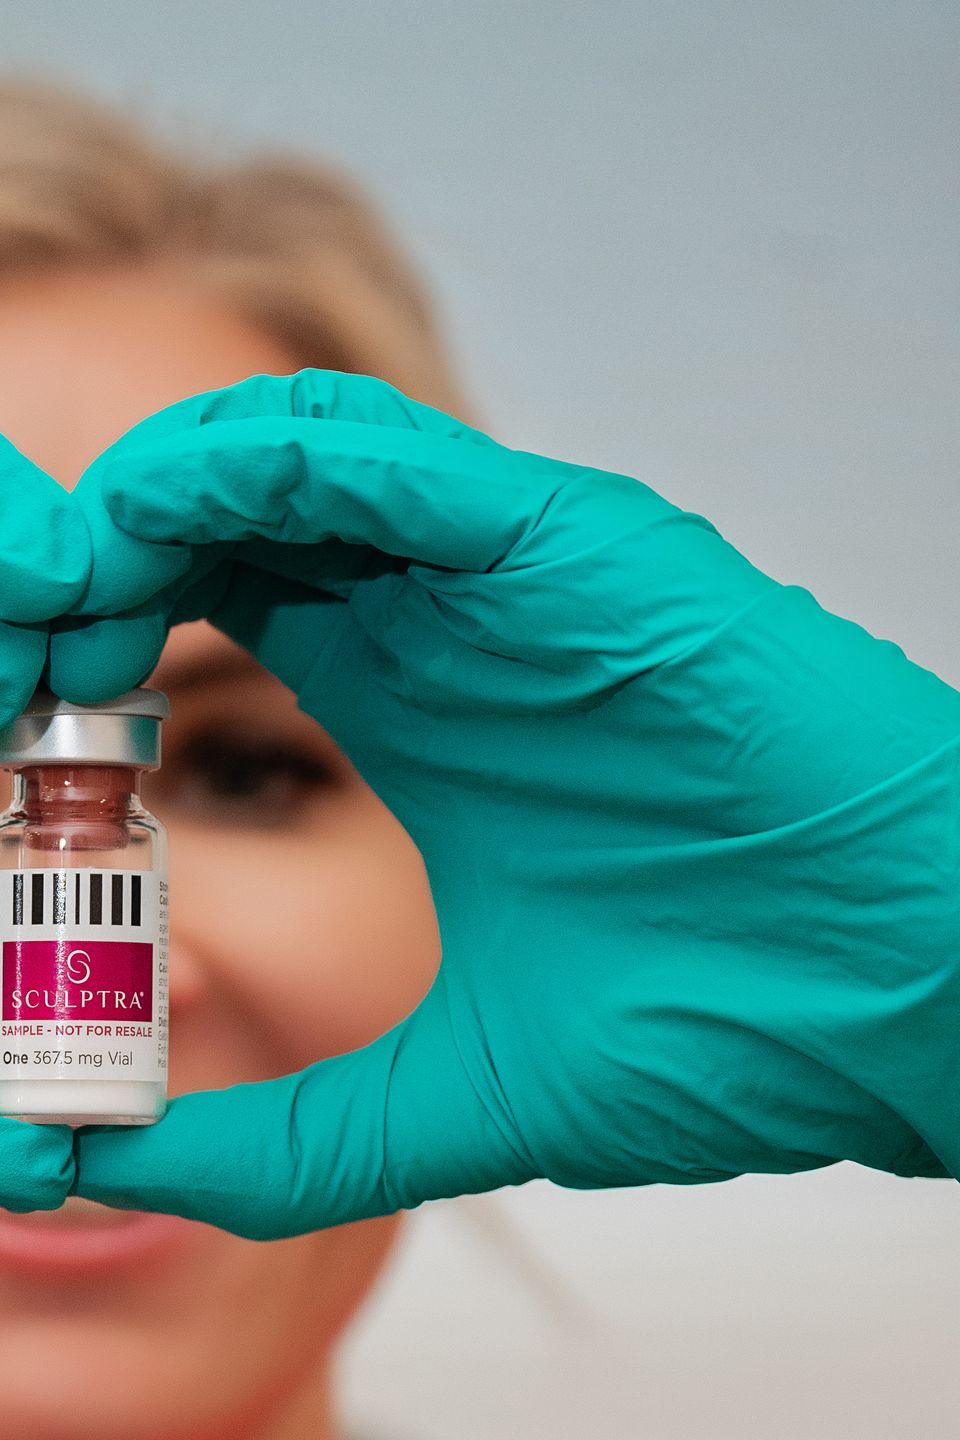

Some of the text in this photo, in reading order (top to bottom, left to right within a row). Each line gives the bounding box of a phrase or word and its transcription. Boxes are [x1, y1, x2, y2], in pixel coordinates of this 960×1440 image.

[1, 1025, 44, 1036] SAMPLE
[55, 1025, 83, 1036] NOT
[86, 1025, 112, 1036] FOR
[115, 1026, 153, 1038] RESALE
[2, 1051, 133, 1068] One 367.5 mg Vial
